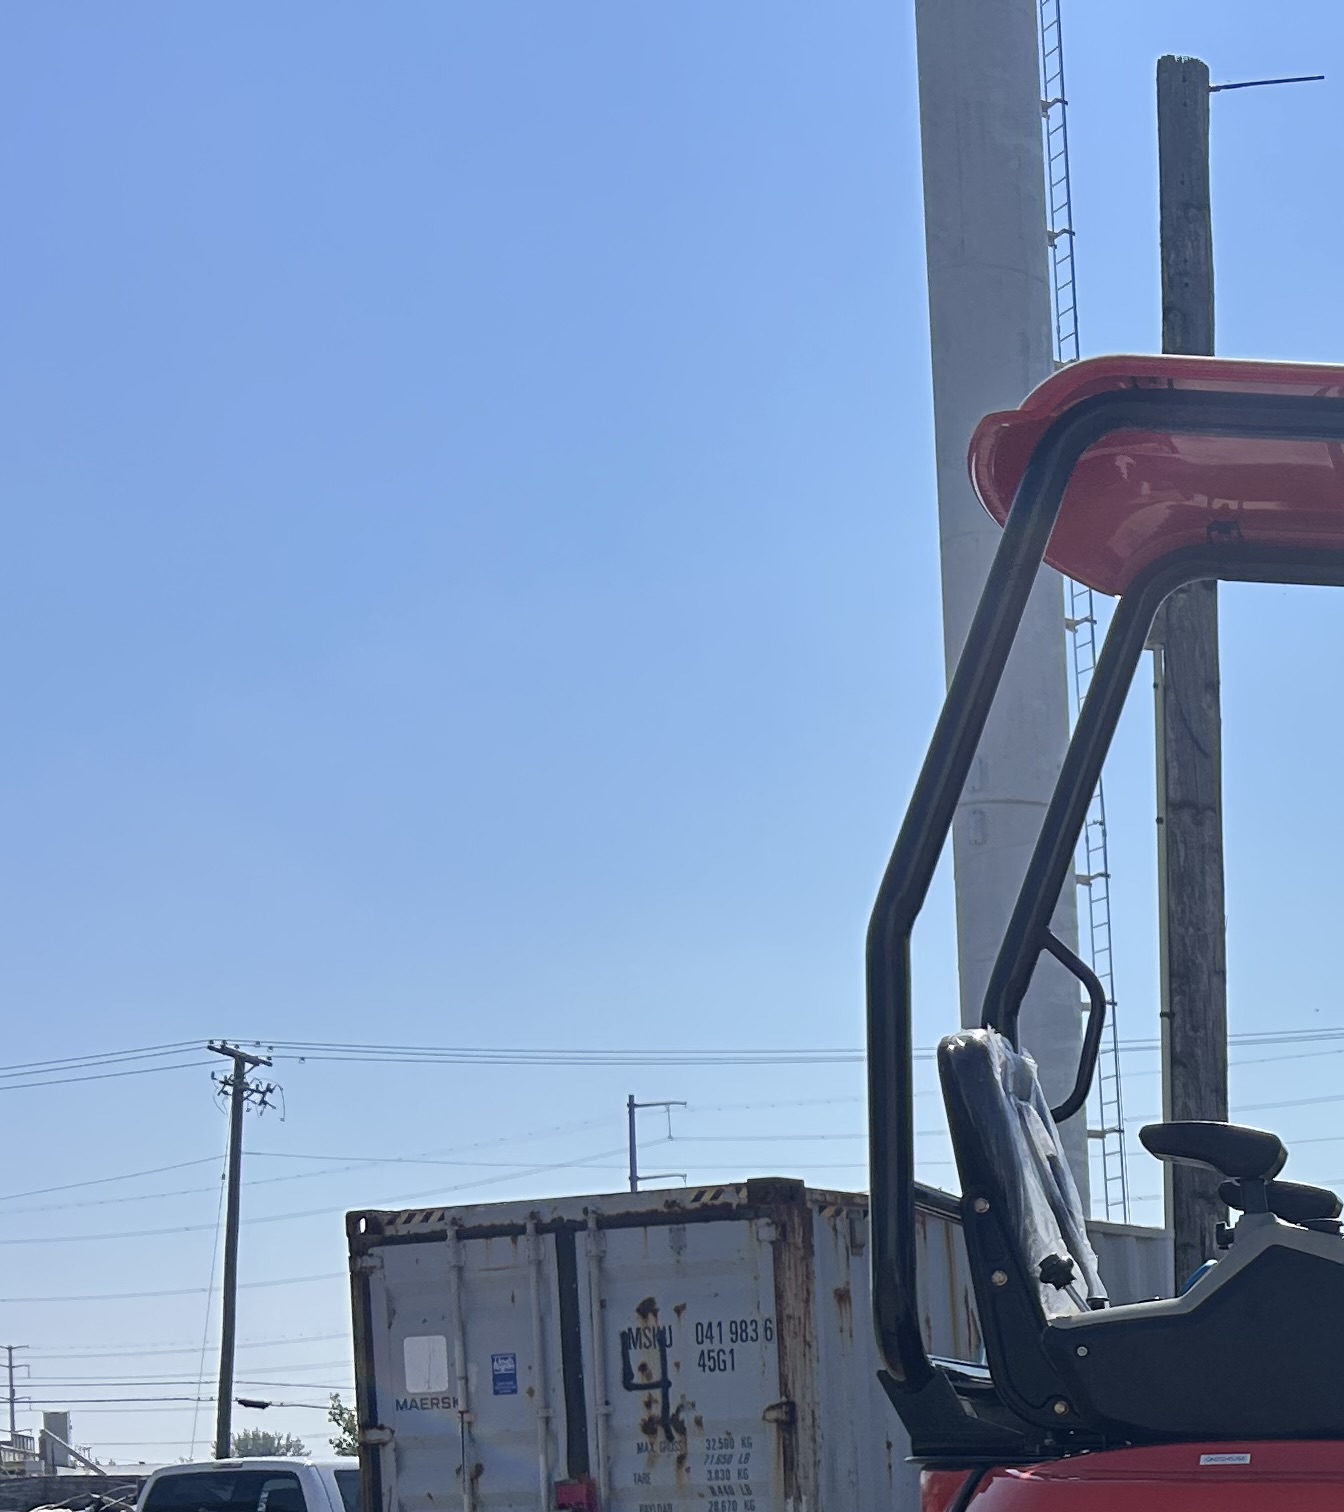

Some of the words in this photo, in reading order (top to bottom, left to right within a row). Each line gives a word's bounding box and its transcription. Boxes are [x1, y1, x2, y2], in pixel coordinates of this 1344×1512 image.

[695, 1321, 723, 1345] 041
[730, 1319, 759, 1343] 983
[764, 1318, 774, 1342] 6
[697, 1348, 736, 1373] 45G1
